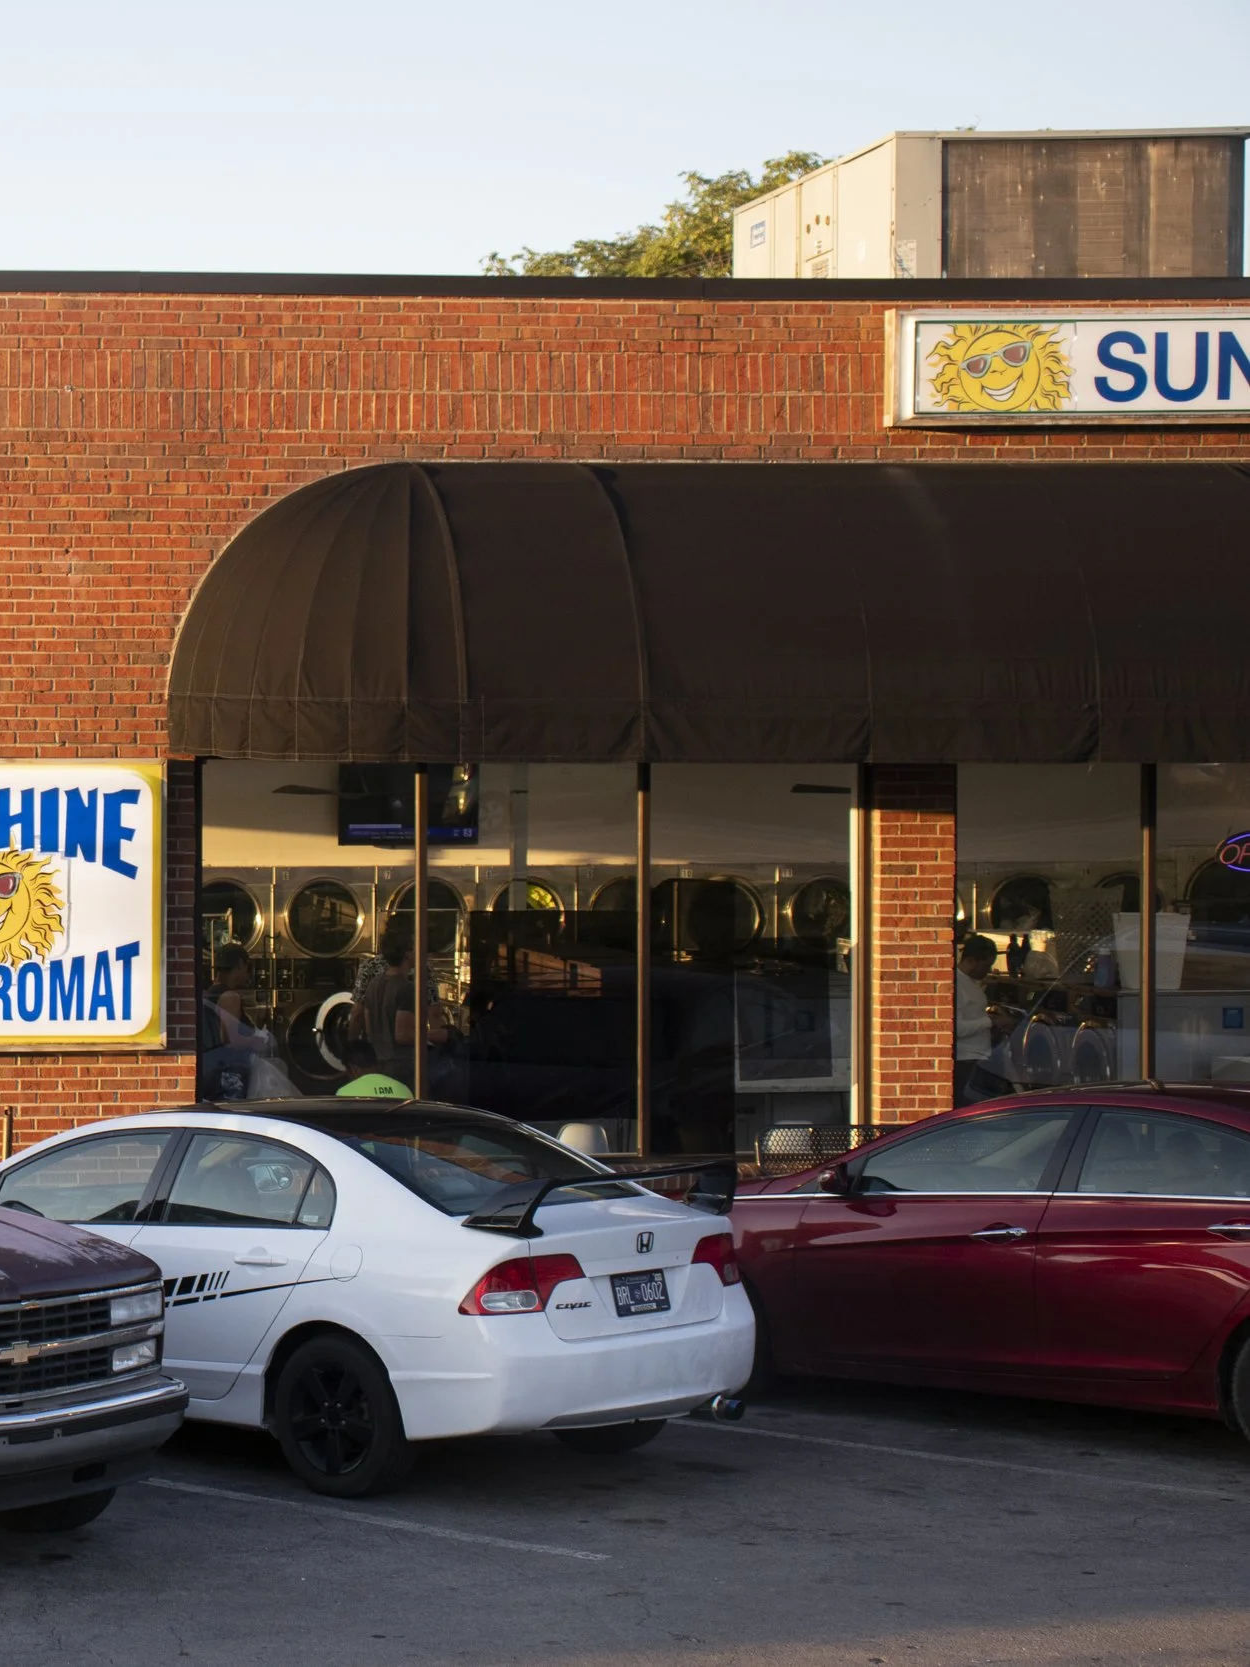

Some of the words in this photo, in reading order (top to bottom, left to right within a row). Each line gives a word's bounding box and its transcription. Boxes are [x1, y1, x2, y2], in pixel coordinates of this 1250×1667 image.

[1094, 331, 1250, 402] SUN
[379, 1087, 393, 1095] AM
[615, 1284, 635, 1306] BRL
[640, 1281, 665, 1302] 0602
[555, 1301, 592, 1311] CIVIC
